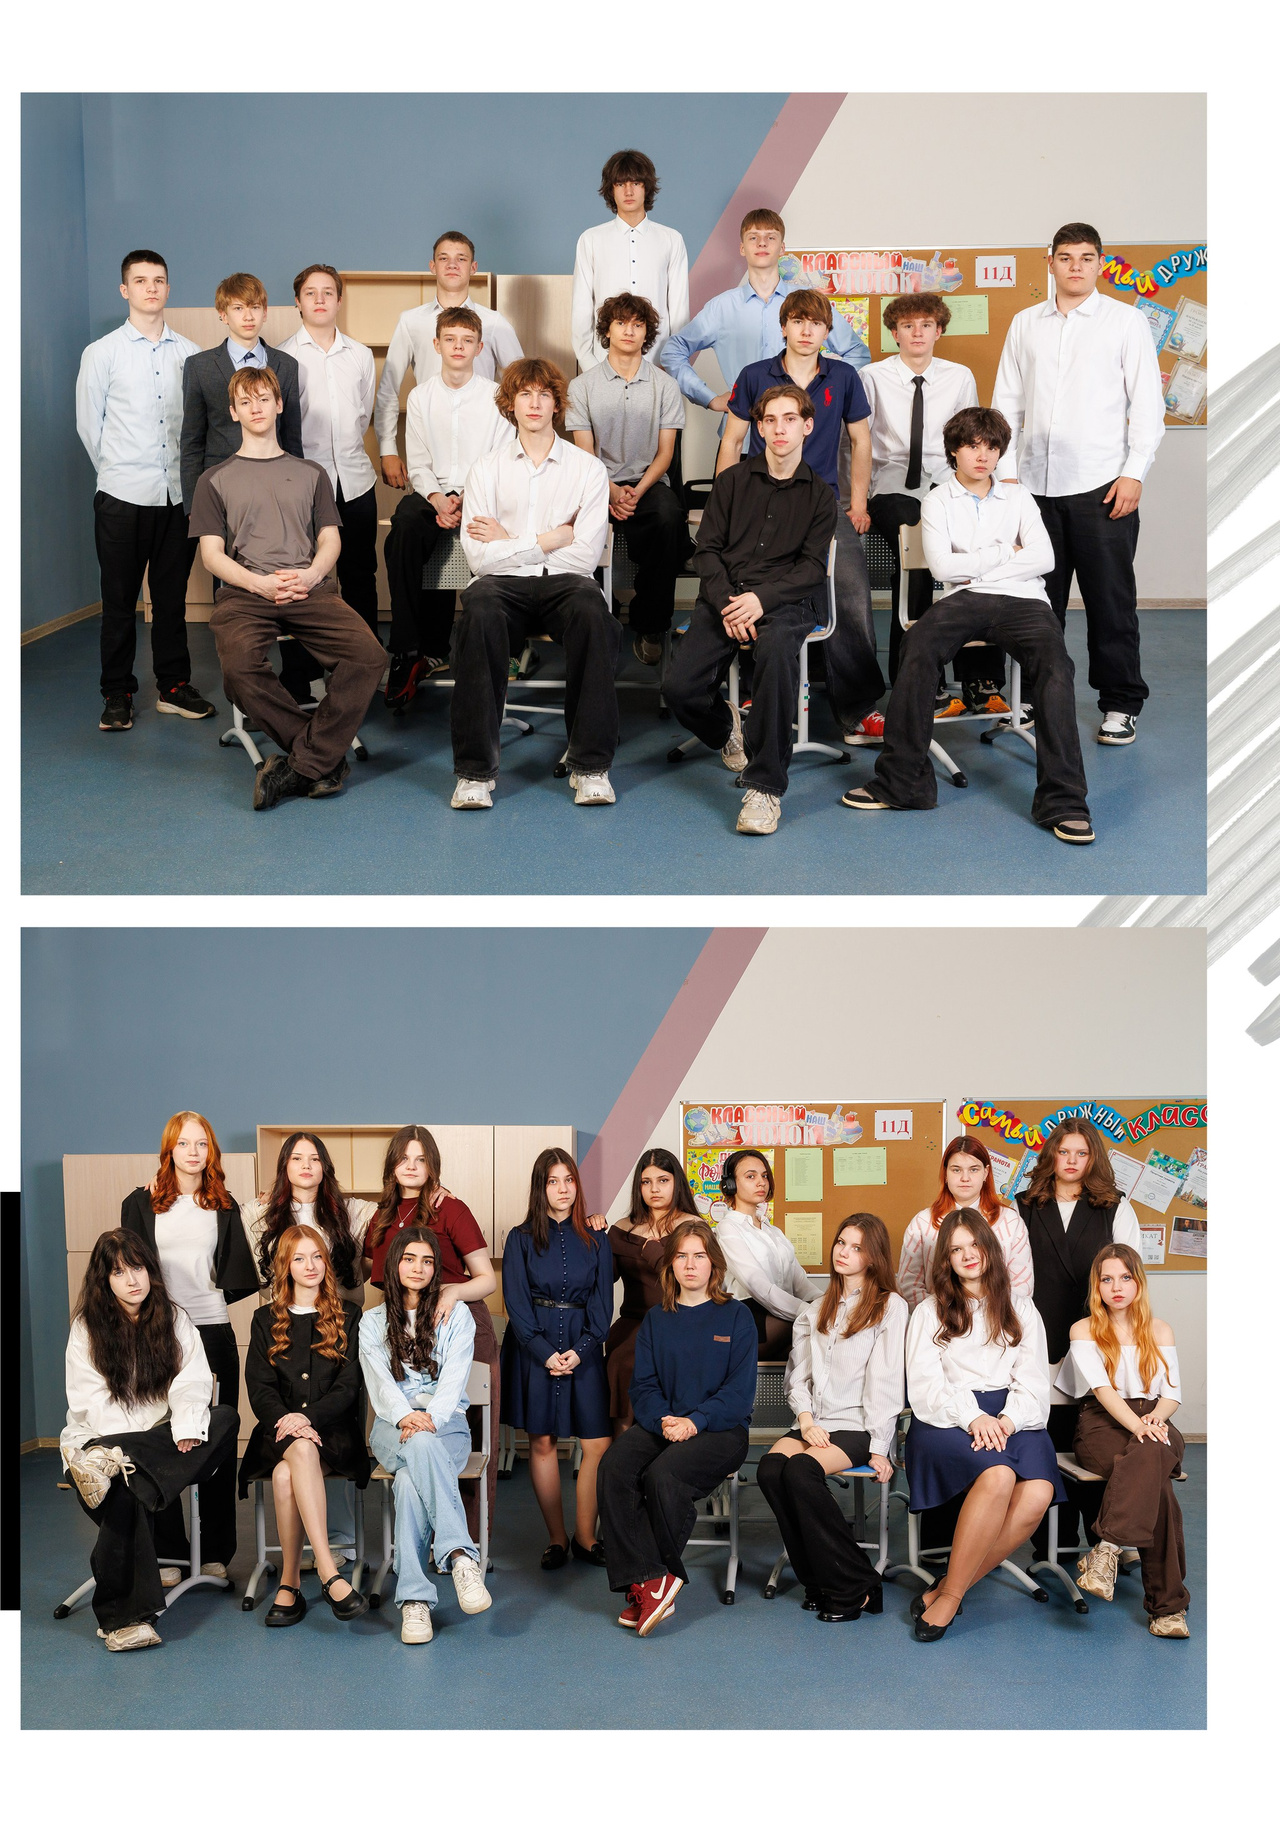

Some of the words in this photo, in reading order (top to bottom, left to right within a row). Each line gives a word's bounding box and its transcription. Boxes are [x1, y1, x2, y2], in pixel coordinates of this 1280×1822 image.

[801, 251, 902, 273] КЛАССНЫЙ
[902, 261, 924, 273] НАШ
[831, 271, 915, 295] УГОЛОК
[983, 266, 1013, 281] 11Д
[1102, 259, 1155, 294] мый
[711, 1105, 806, 1125] КЛАССНЫЙ
[806, 1114, 826, 1125] НАШ
[962, 1103, 1042, 1147] Самый
[740, 1124, 818, 1146] УГОЛОК
[881, 1120, 910, 1135] 11Д
